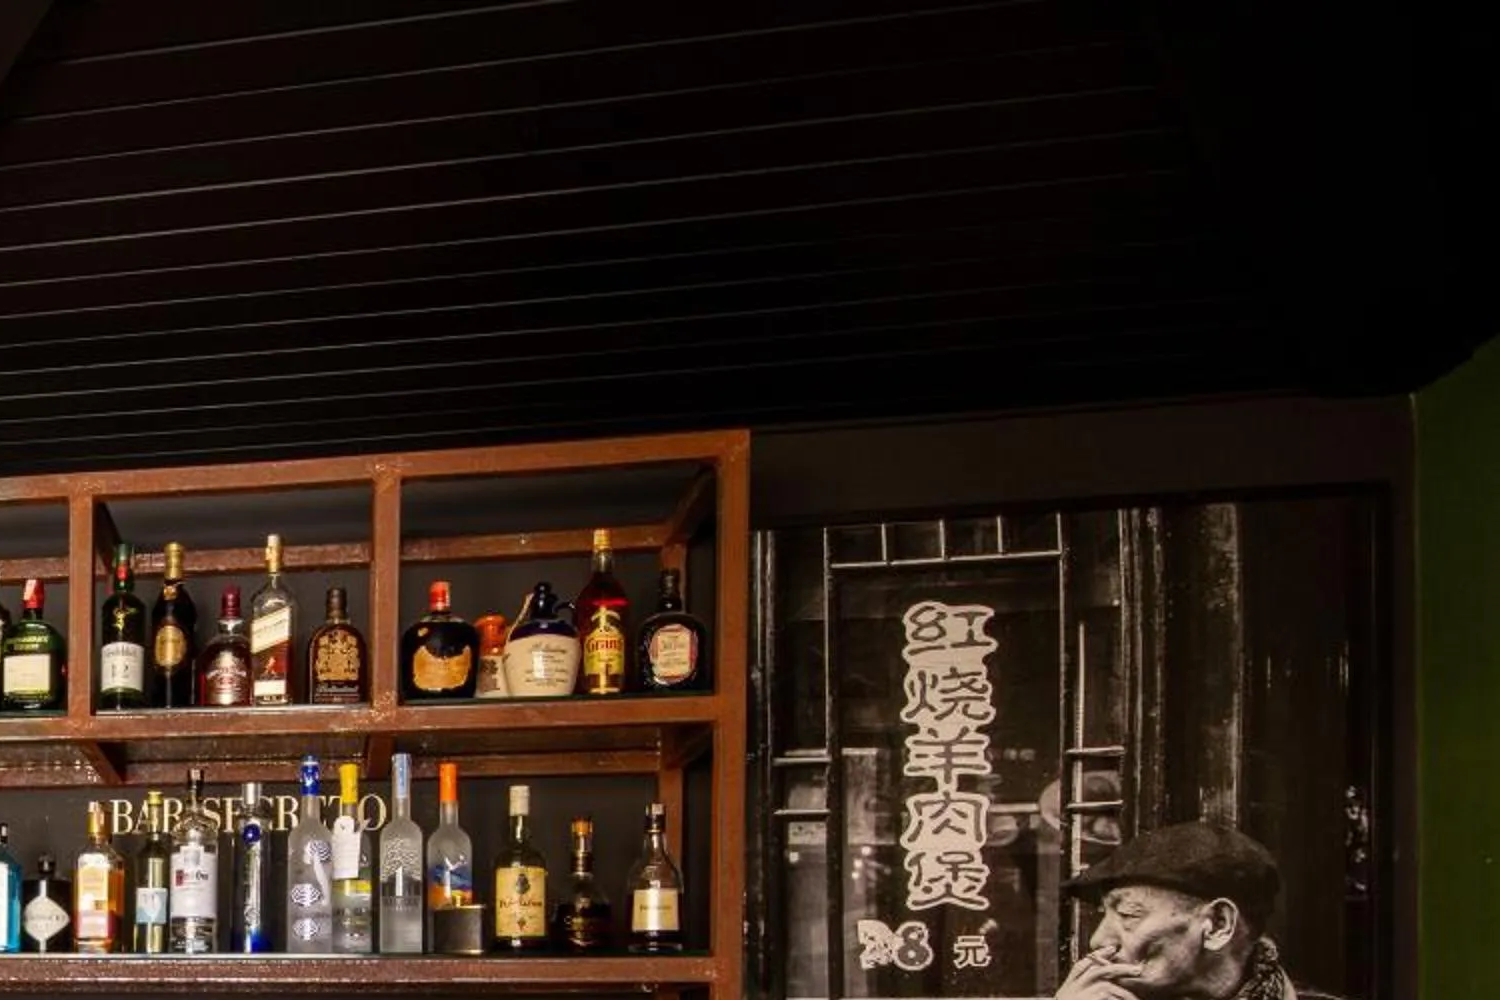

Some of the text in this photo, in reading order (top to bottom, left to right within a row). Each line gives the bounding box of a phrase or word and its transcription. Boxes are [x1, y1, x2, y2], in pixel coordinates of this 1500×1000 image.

[901, 602, 998, 910] 红烧羊肉煲
[110, 799, 184, 834] BAR
[953, 935, 993, 969] 元
